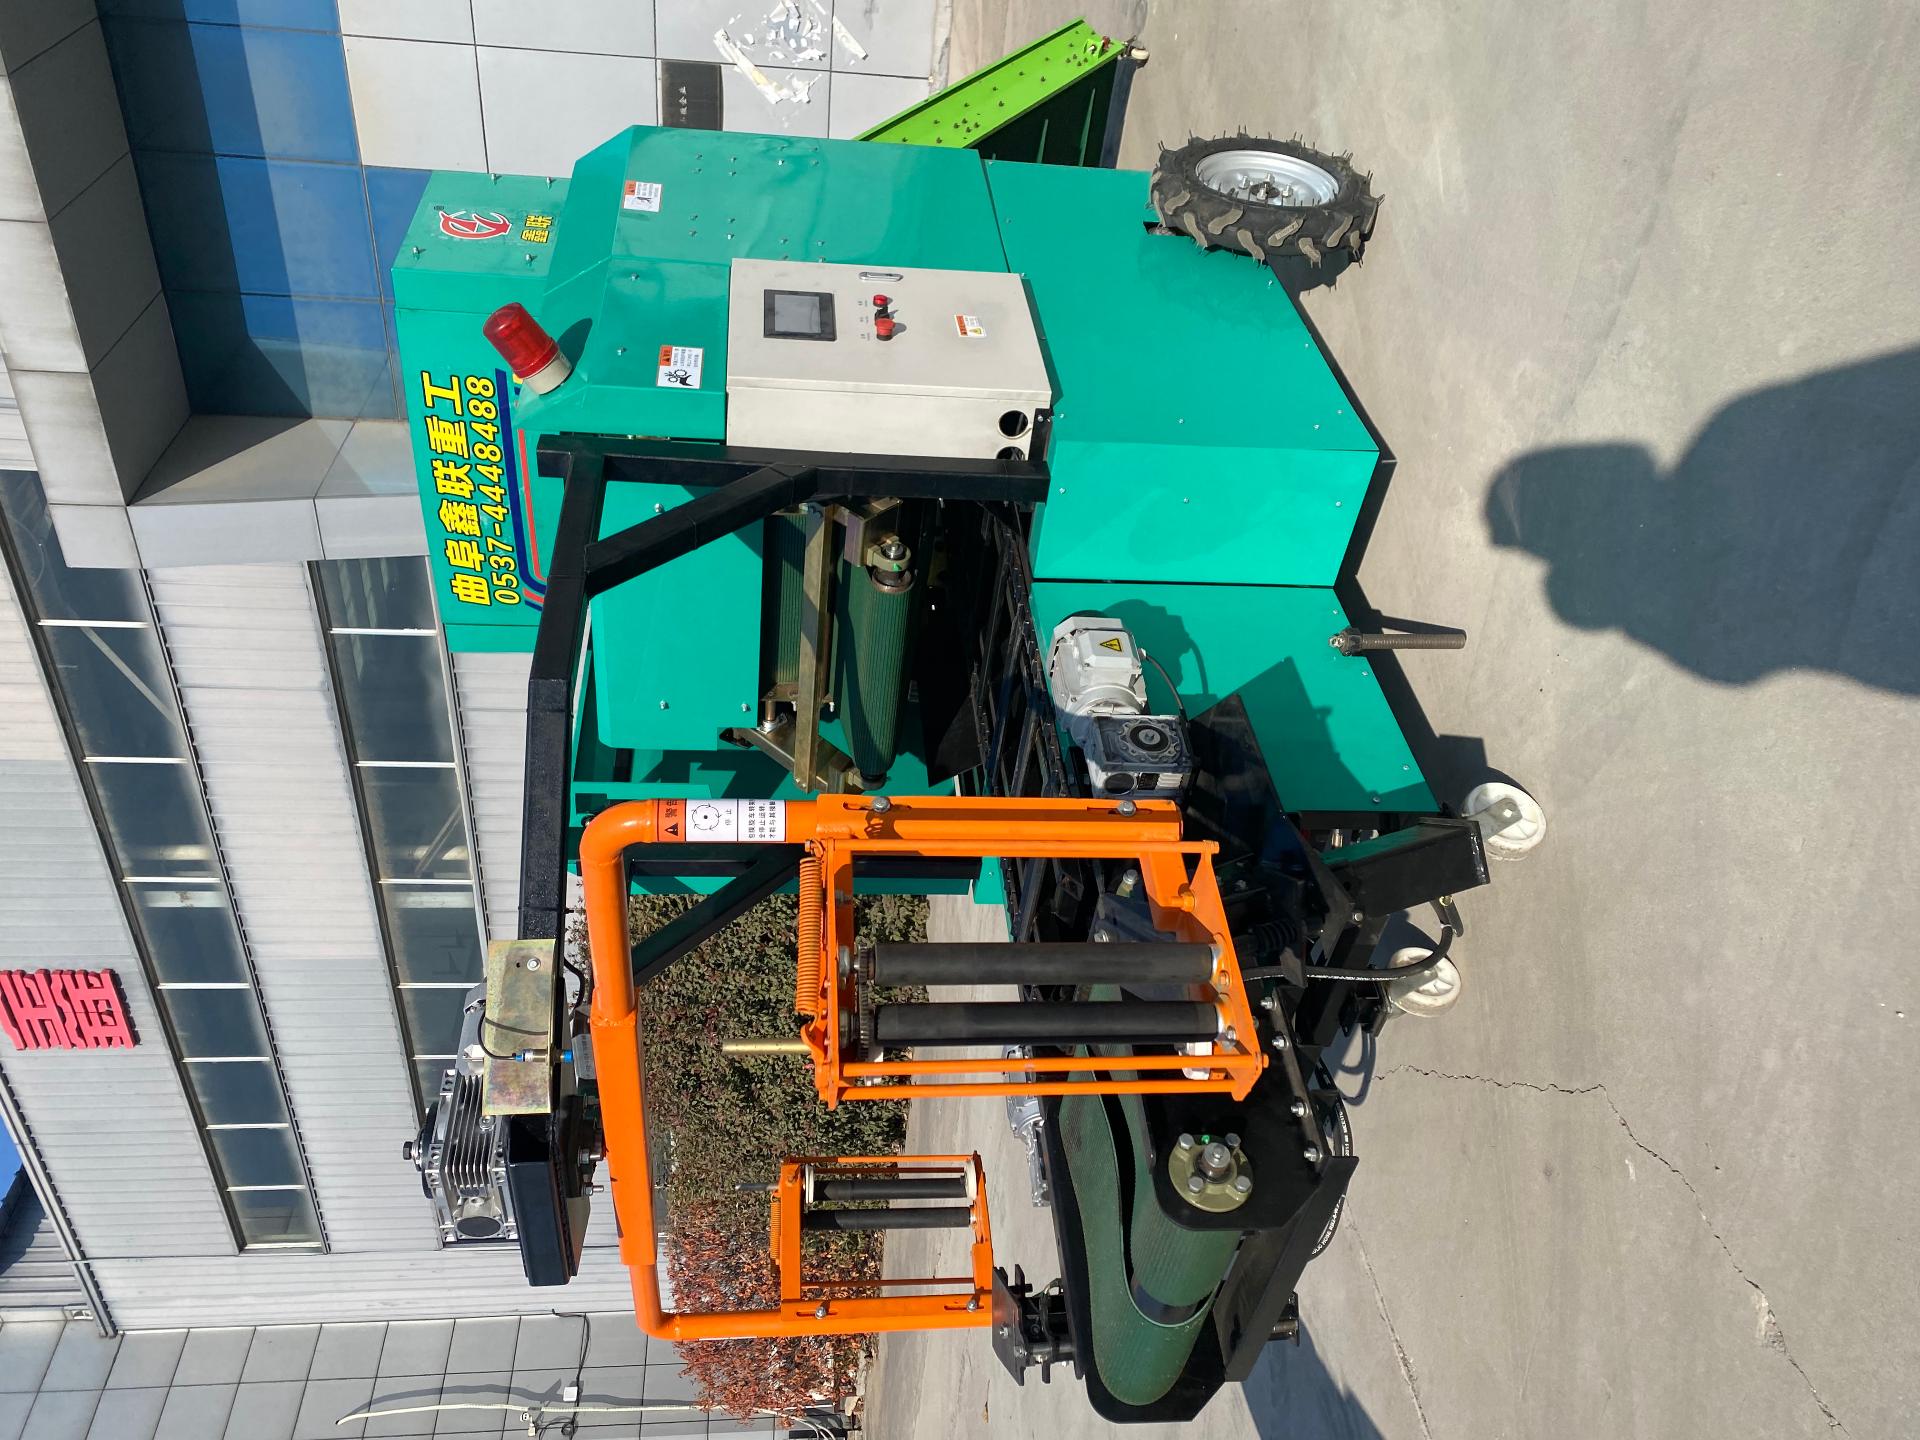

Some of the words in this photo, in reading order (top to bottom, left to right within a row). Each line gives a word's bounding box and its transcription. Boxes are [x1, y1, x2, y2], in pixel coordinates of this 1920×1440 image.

[521, 215, 553, 243] 鑫联
[421, 370, 492, 606] 曲阜鑫联重工
[464, 375, 521, 606] 0537-4448488
[724, 808, 733, 826] 停止
[0, 968, 136, 1050] 鑫
